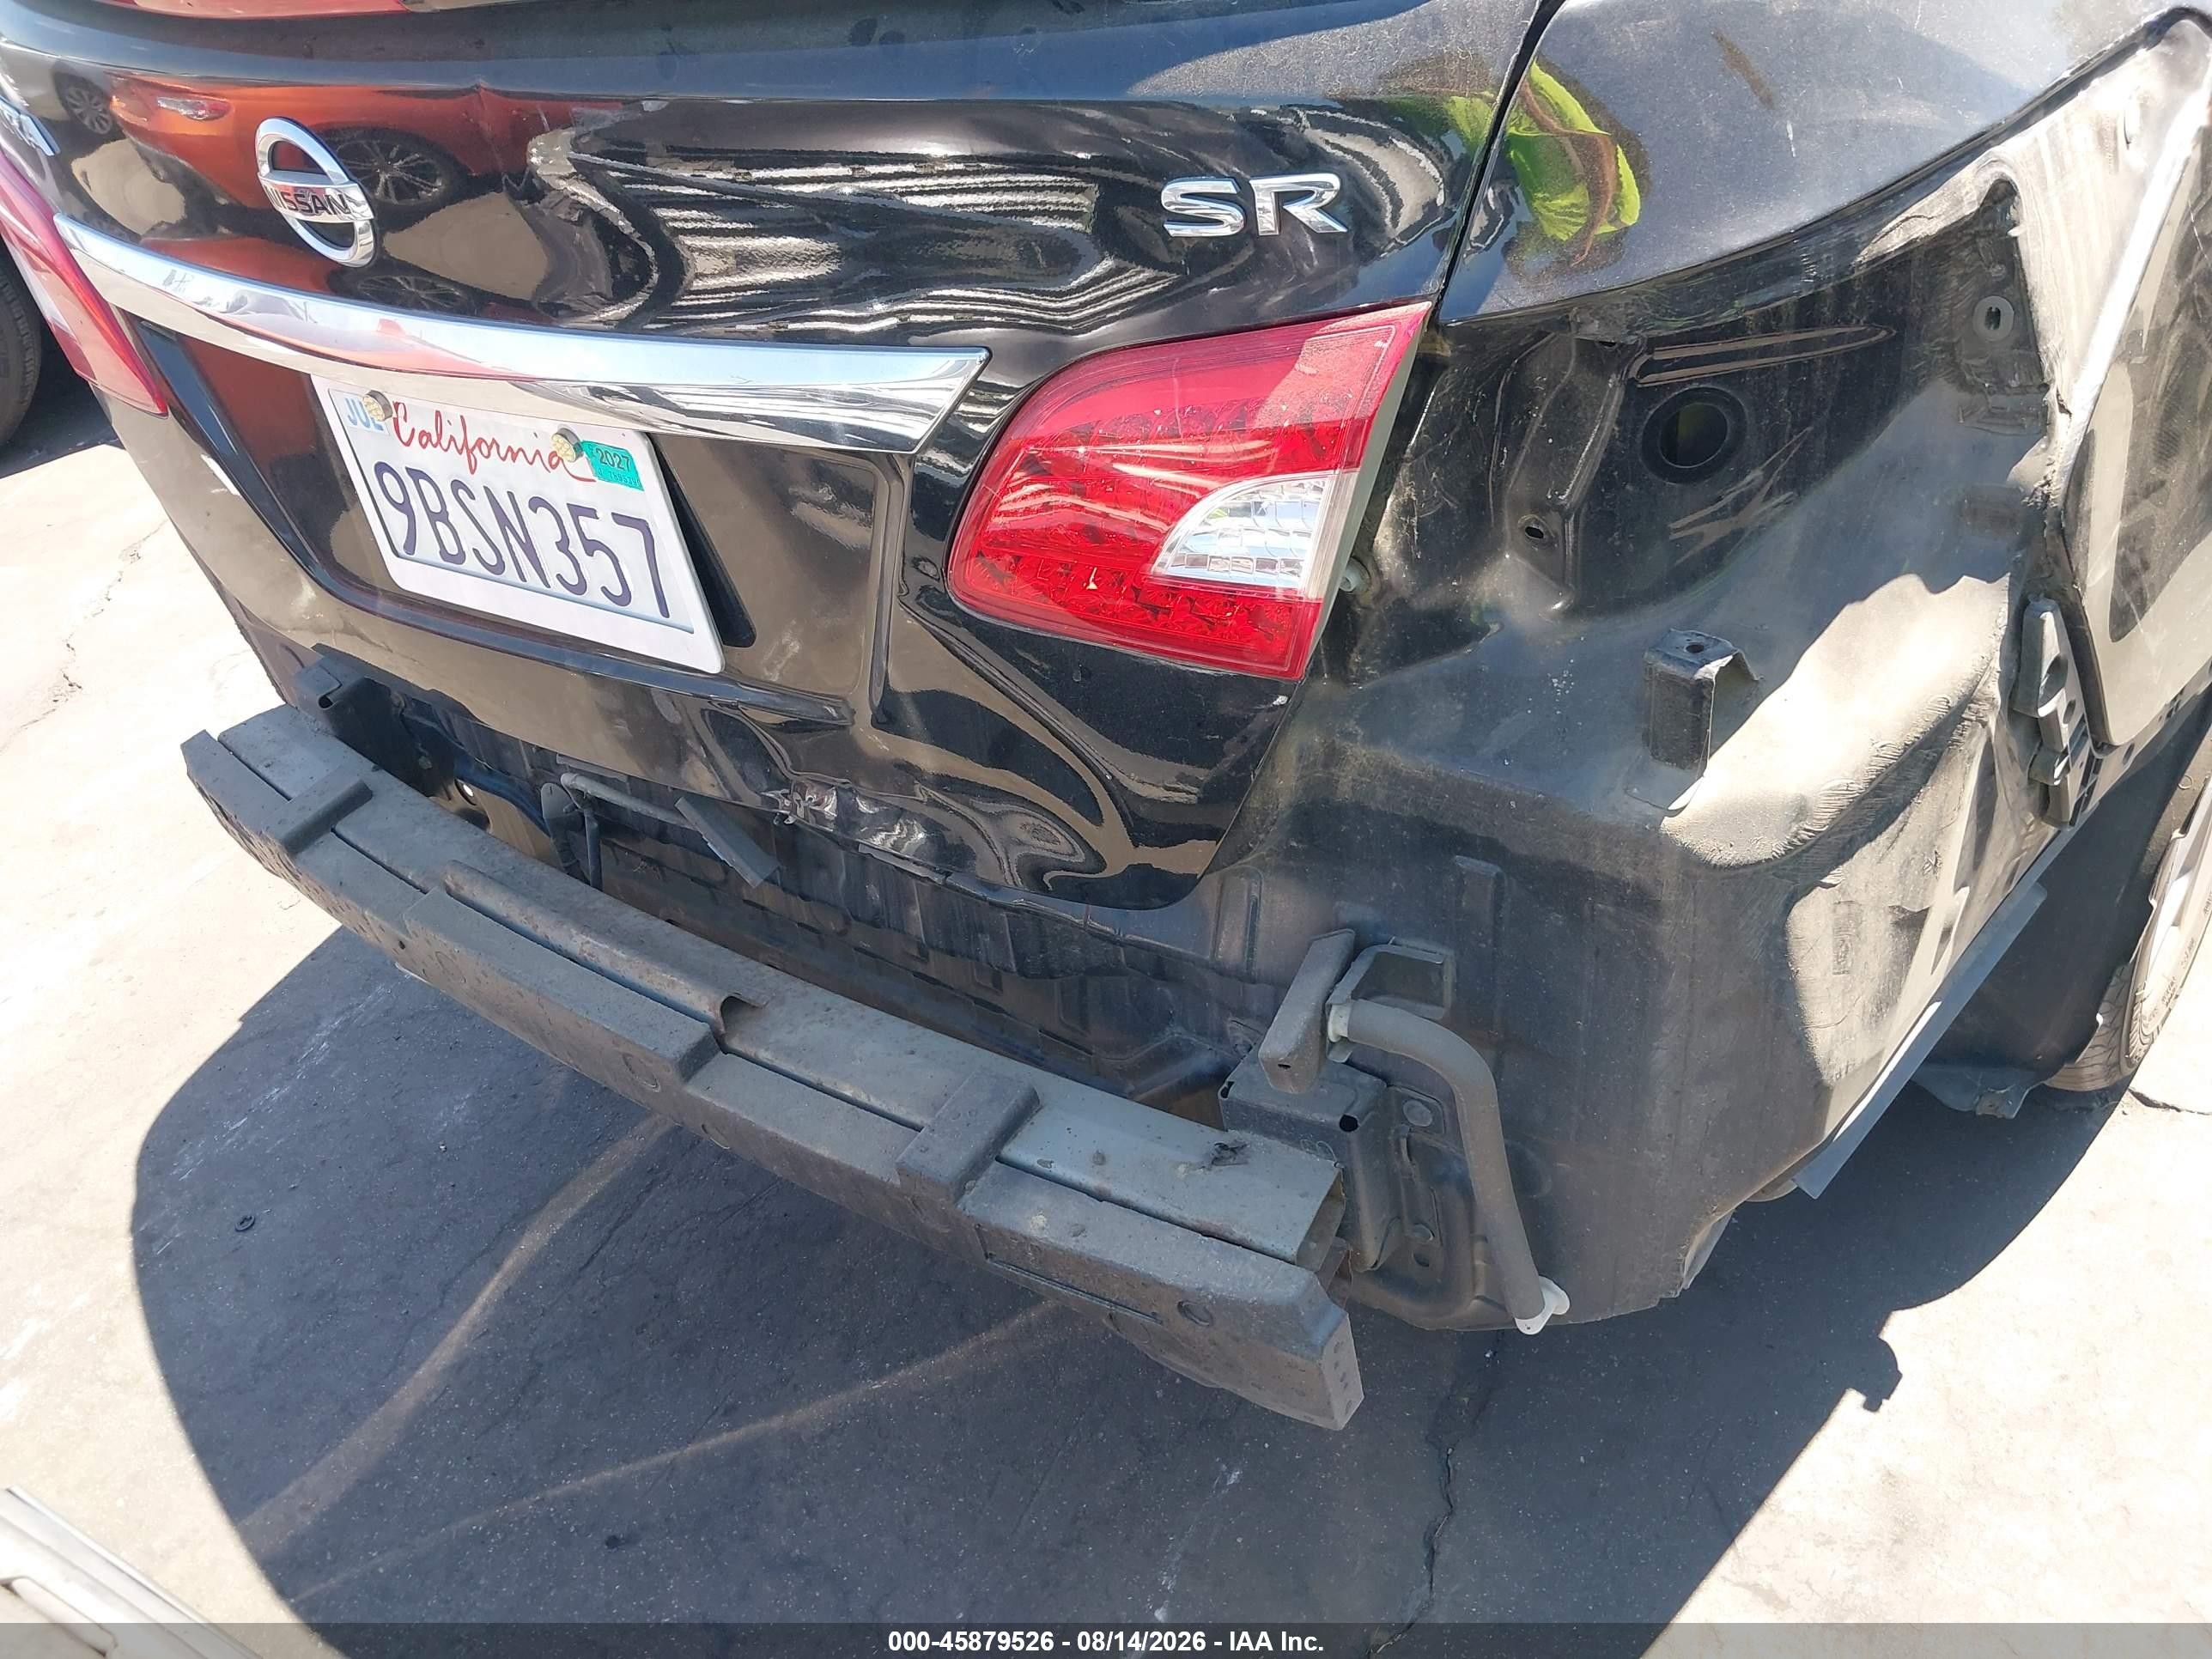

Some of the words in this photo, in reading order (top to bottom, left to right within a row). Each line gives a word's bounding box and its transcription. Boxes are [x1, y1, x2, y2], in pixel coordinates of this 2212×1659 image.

[264, 184, 355, 216] NISSAN
[1161, 173, 1347, 237] SR
[392, 401, 597, 483] California
[596, 447, 630, 471] 2027
[374, 460, 671, 619] 9BSN357
